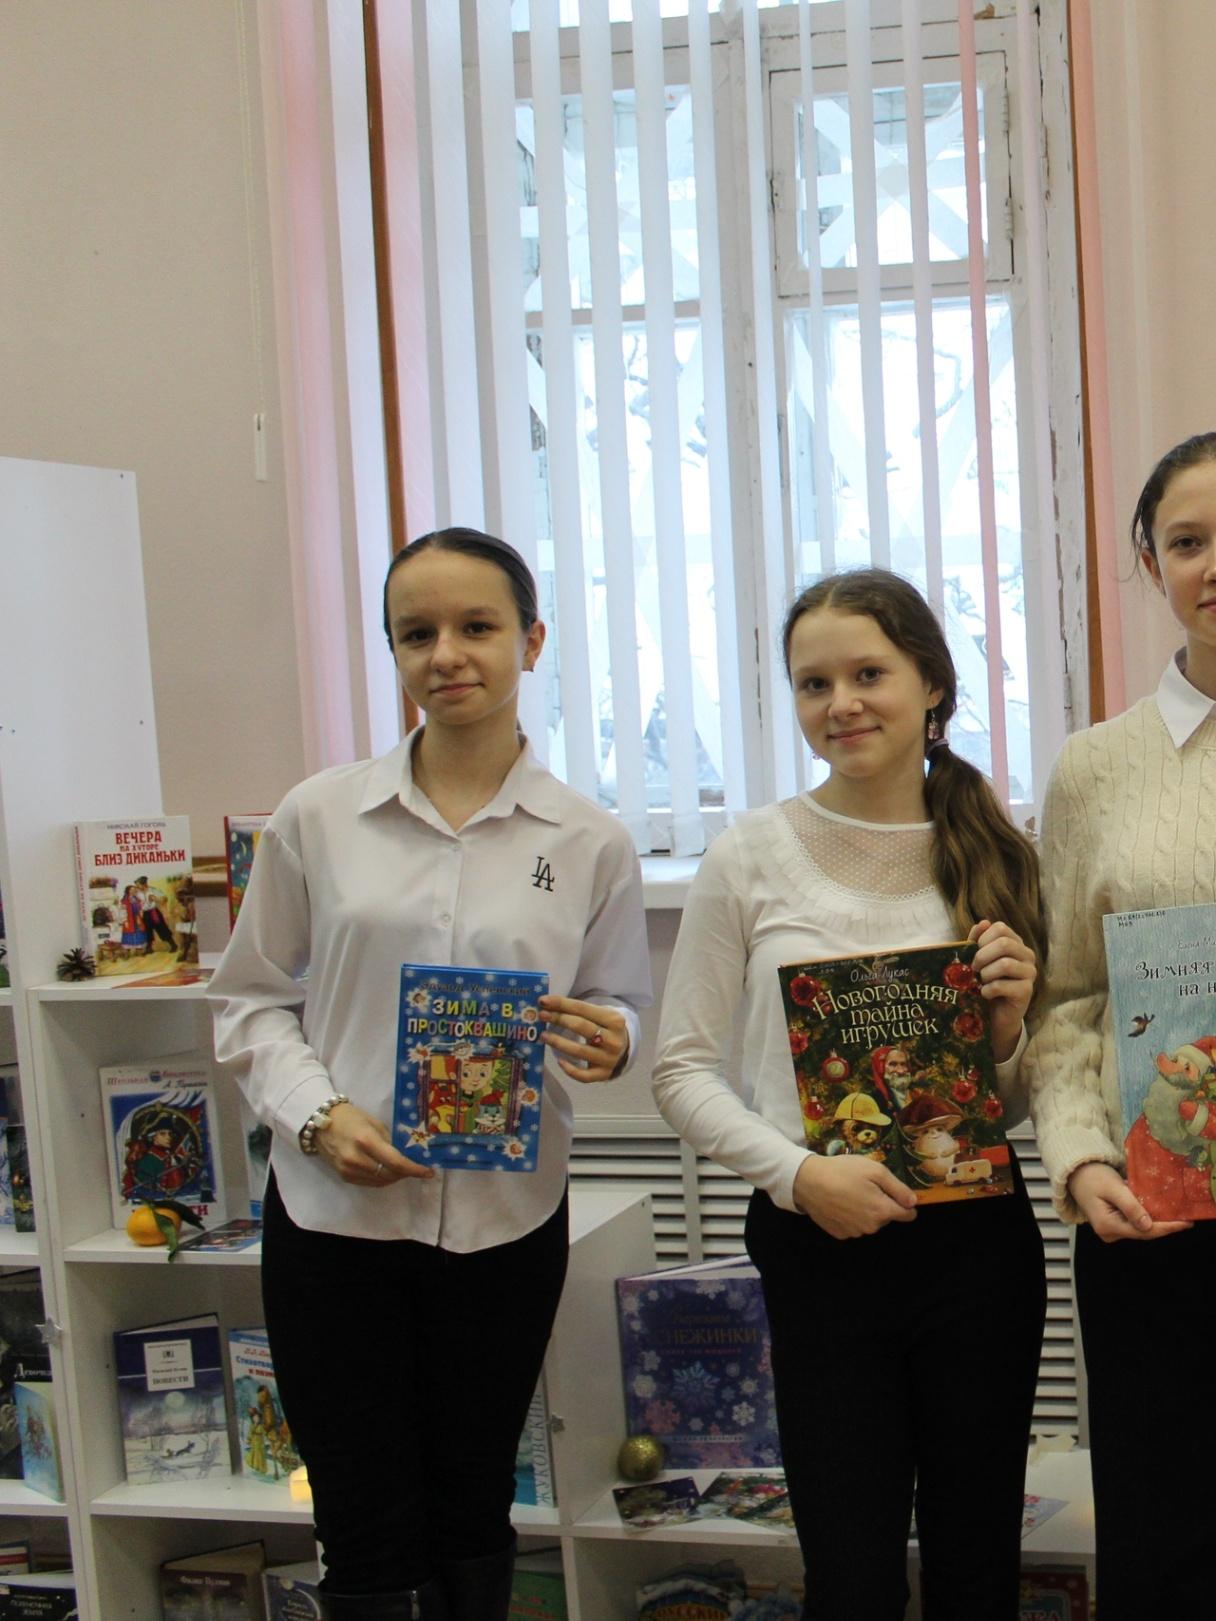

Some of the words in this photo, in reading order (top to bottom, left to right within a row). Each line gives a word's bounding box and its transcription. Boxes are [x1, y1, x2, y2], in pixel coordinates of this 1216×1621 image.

[114, 830, 163, 845] ВЕЧЕРА
[93, 853, 123, 868] БЛИЗ
[125, 849, 186, 867] ДИКАНЬКИ
[531, 856, 555, 892] LA
[1134, 959, 1215, 981] Зимняя
[1178, 982, 1200, 997] на
[431, 999, 491, 1017] ЗИМА
[500, 1003, 516, 1018] В
[811, 983, 960, 1021] Новогодняя
[850, 1000, 925, 1026] тайна
[406, 1018, 538, 1042] ПРОСТОКВАШИНО
[840, 1016, 940, 1050] игрушек
